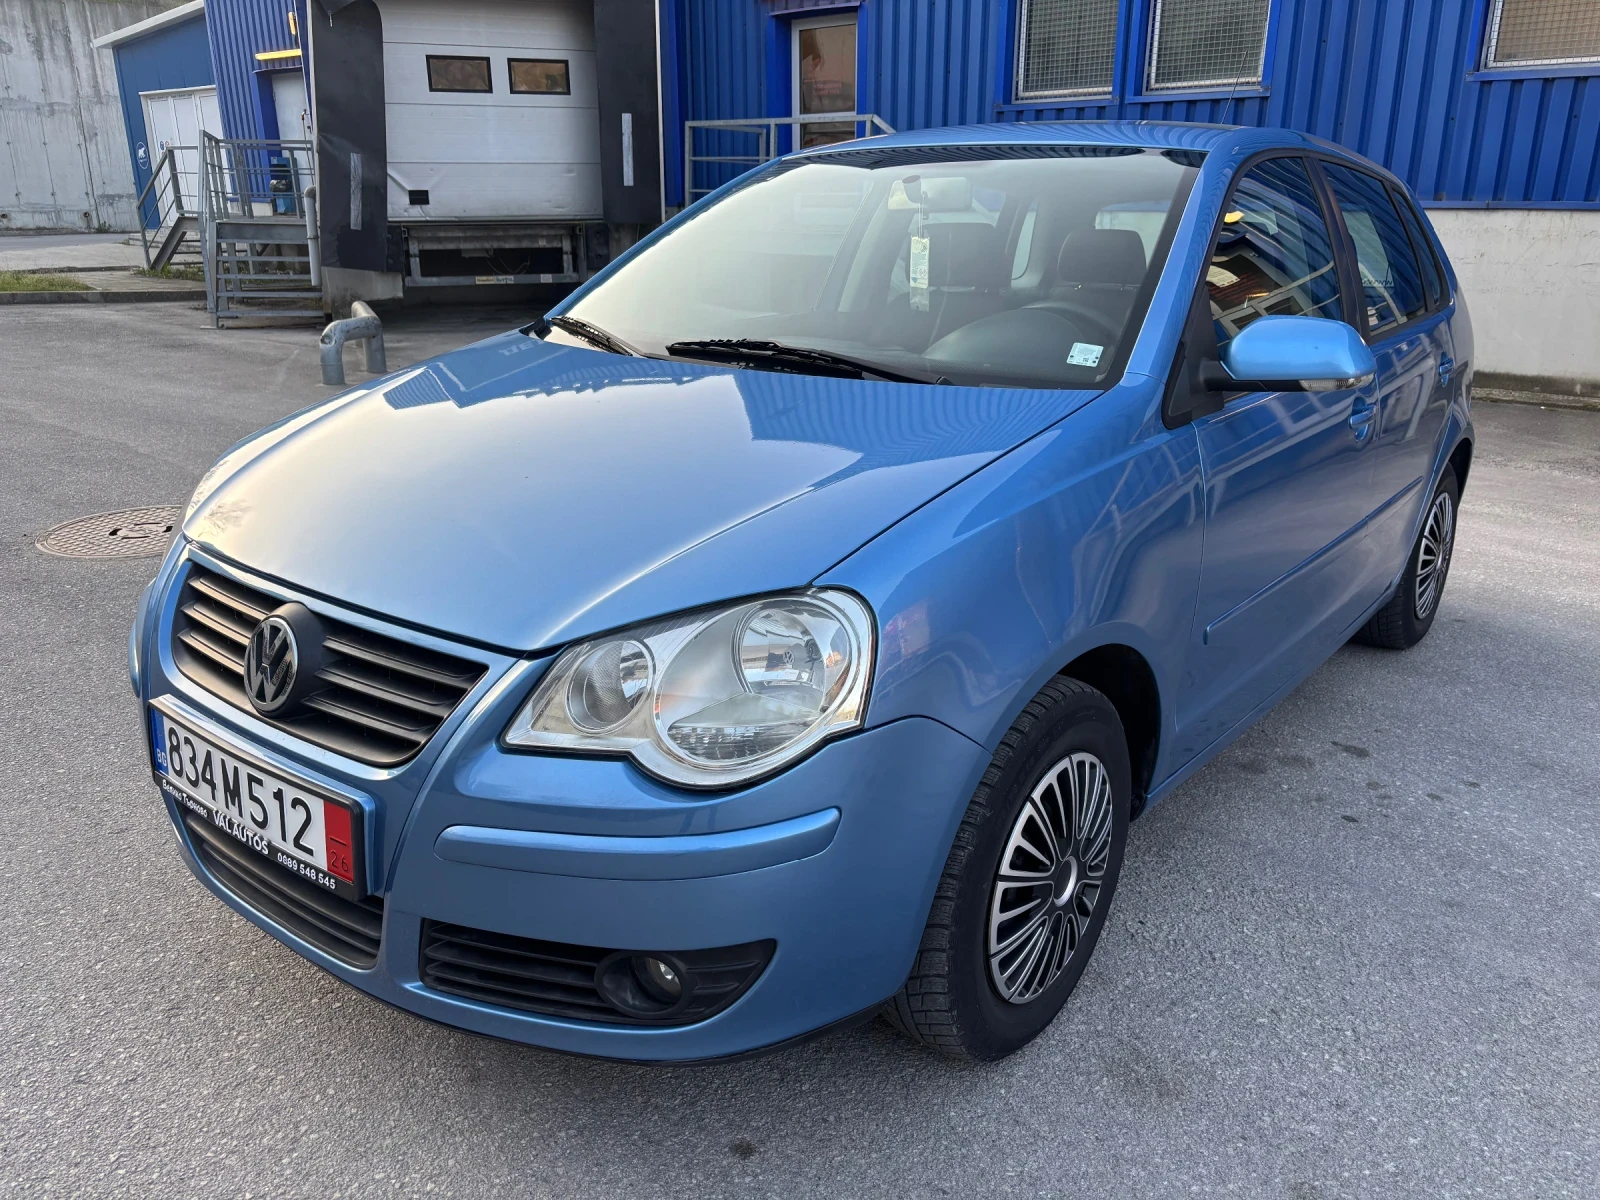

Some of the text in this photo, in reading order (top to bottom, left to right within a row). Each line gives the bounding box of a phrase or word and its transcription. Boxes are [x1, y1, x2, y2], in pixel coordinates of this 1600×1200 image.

[156, 747, 167, 767] BG
[277, 852, 336, 890] 0889 548 545
[330, 849, 349, 872] 26
